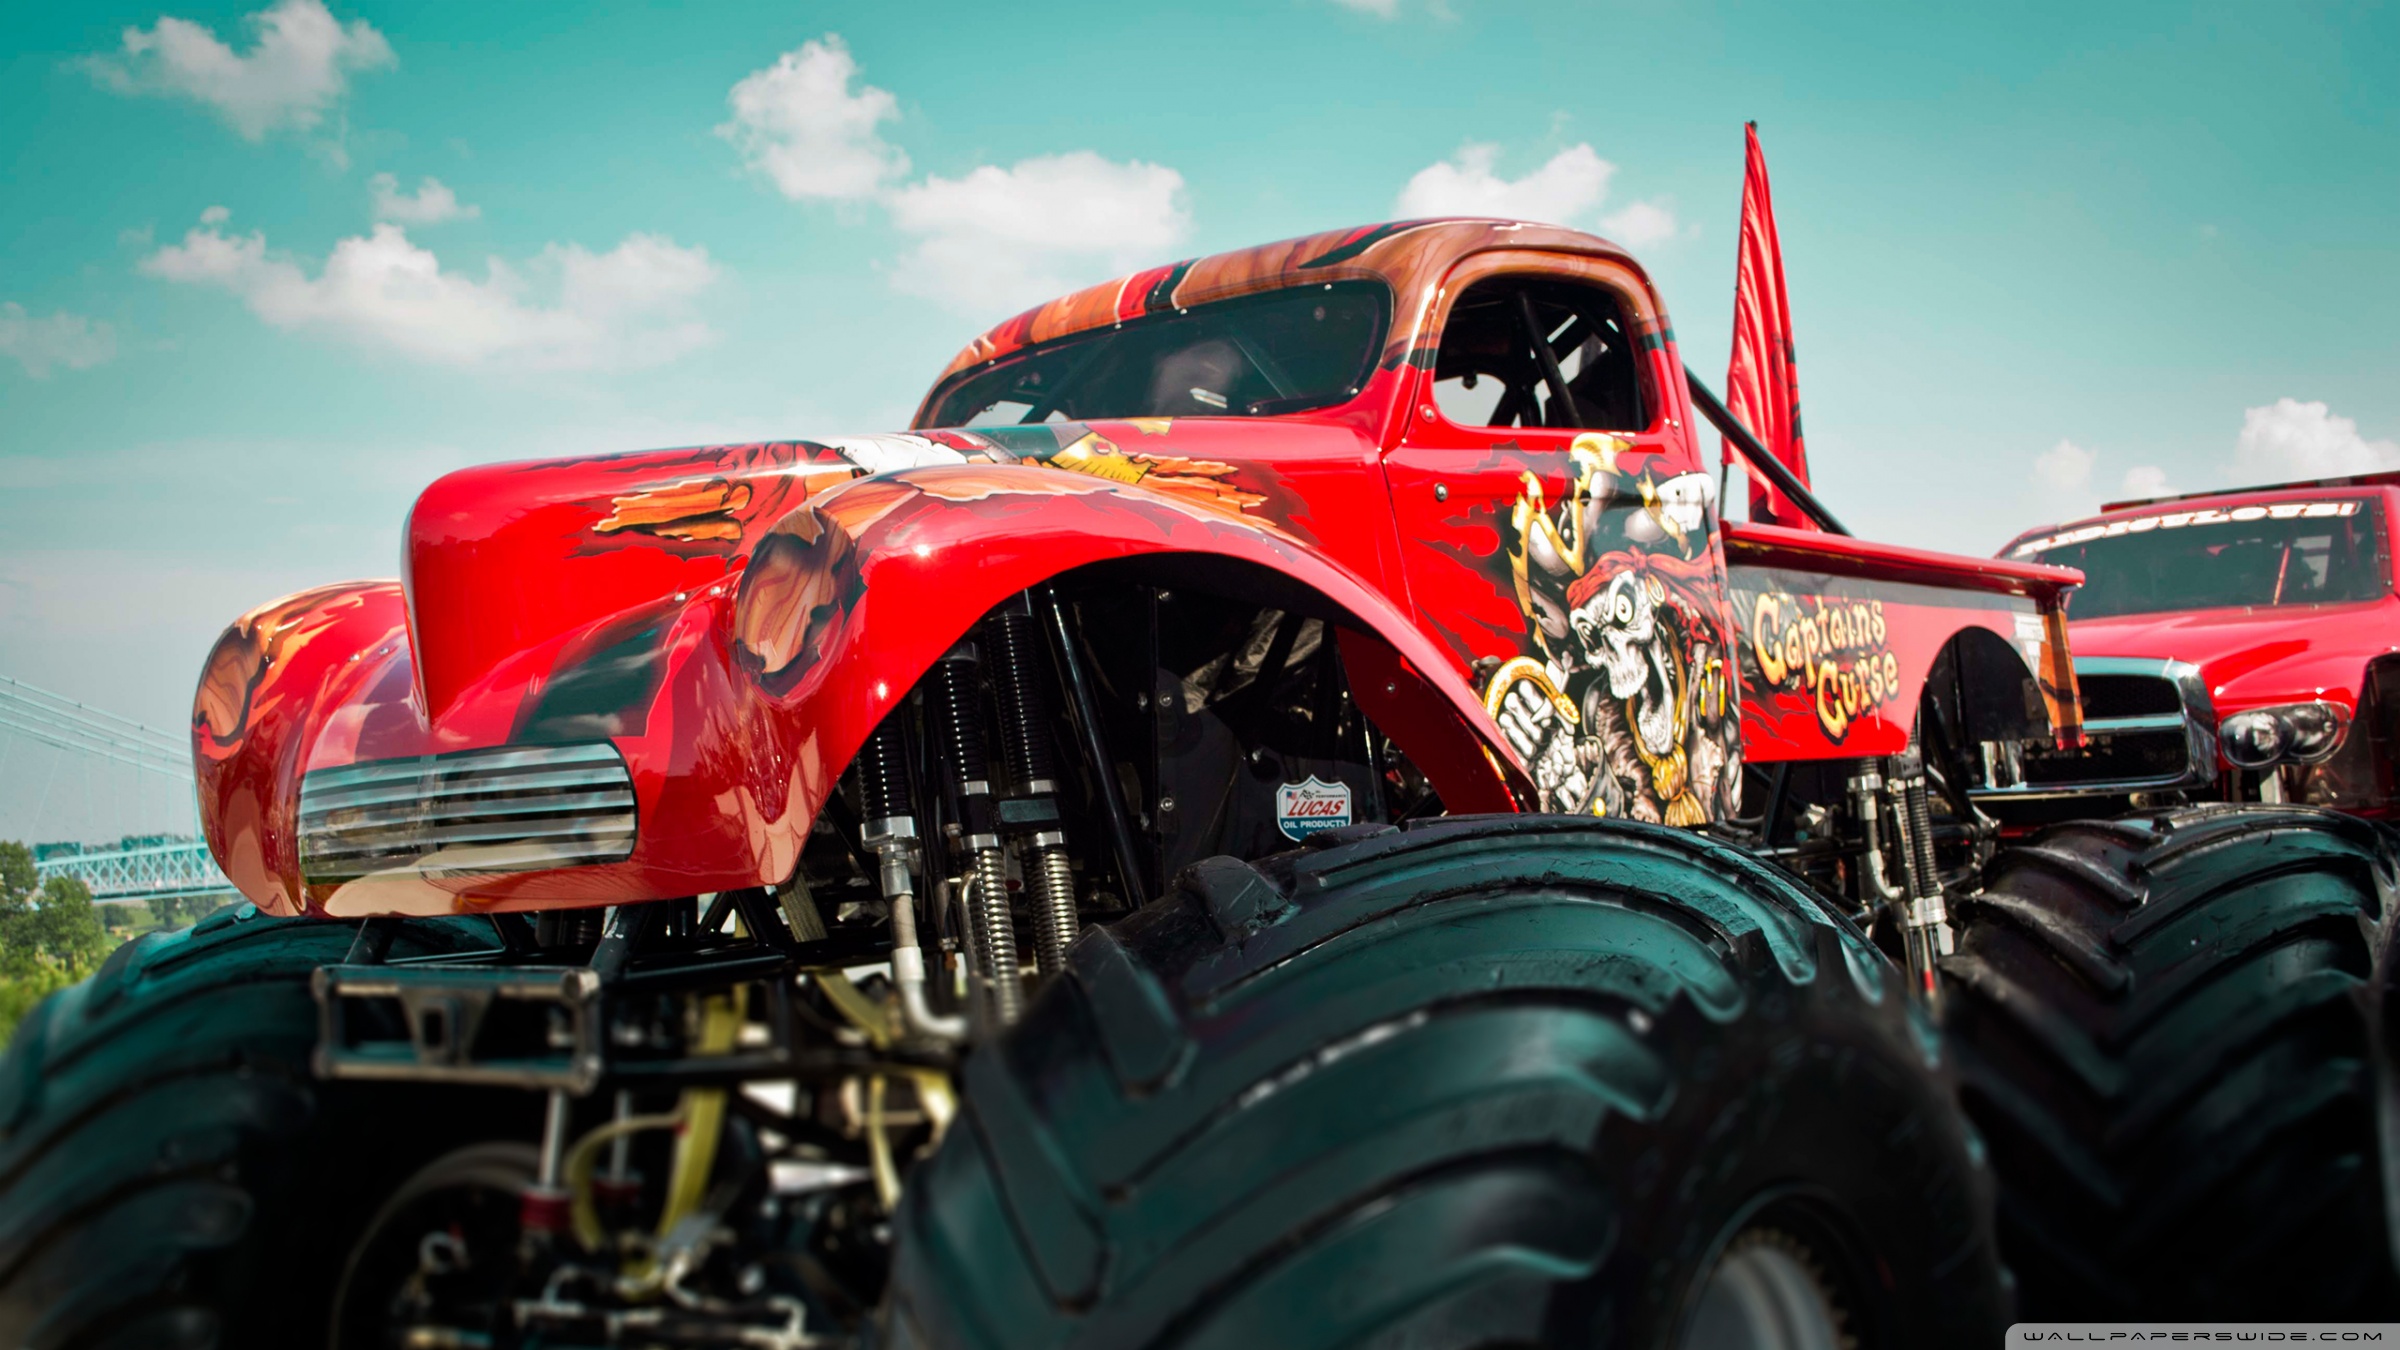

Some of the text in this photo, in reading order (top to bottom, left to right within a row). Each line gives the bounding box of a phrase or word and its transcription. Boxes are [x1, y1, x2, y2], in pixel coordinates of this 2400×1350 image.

[1753, 592, 1886, 689] Captains
[1816, 651, 1899, 739] Curse
[1283, 820, 1347, 829] OIL PRODUCTS
[1287, 800, 1345, 816] LUCAS
